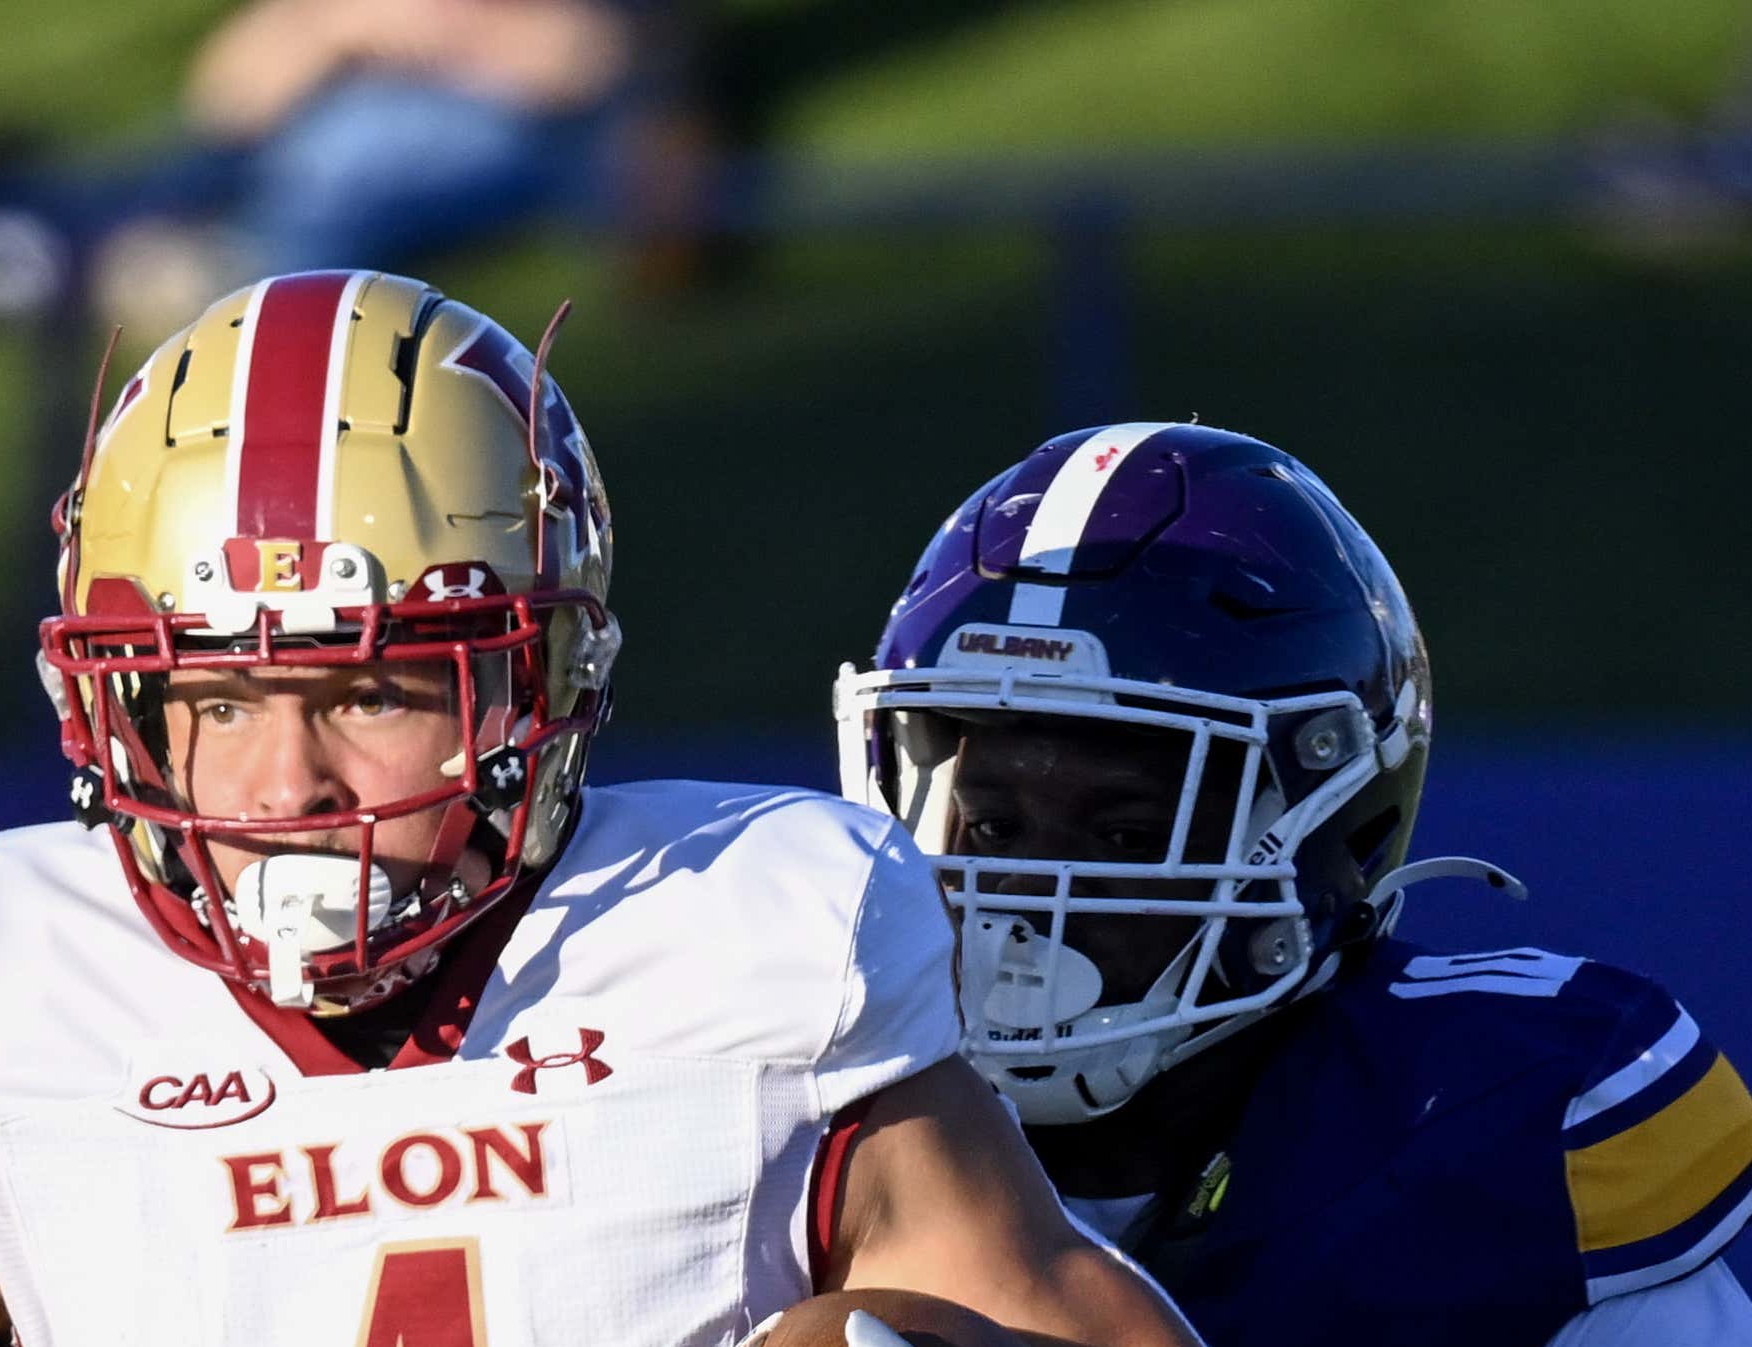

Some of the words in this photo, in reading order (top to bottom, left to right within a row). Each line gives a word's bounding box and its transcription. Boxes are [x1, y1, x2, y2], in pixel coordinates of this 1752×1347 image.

[253, 540, 303, 592] E
[957, 631, 1075, 662] UALBANY
[138, 1069, 251, 1110] CAA
[217, 1120, 551, 1233] ELON
